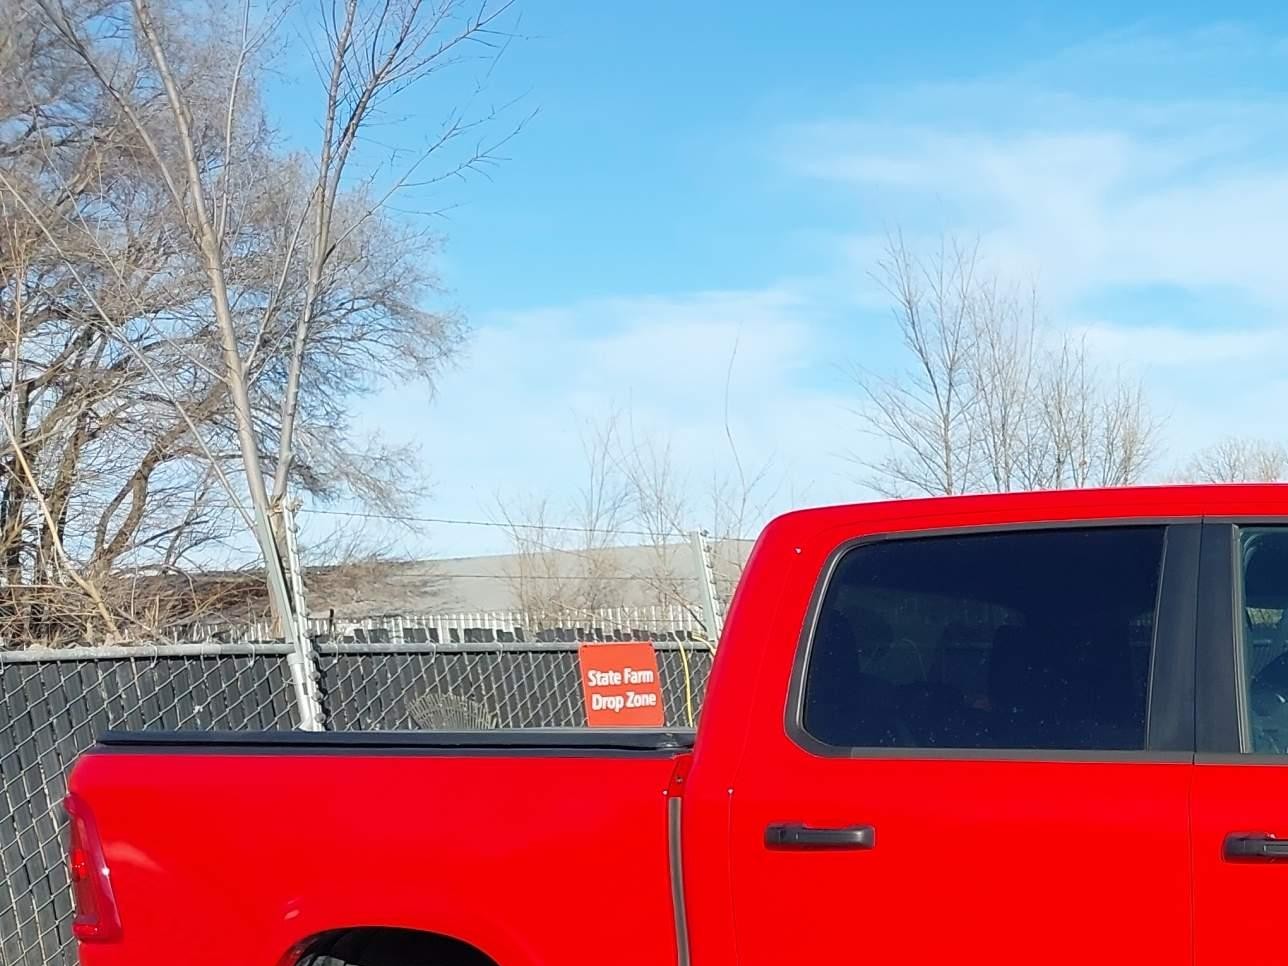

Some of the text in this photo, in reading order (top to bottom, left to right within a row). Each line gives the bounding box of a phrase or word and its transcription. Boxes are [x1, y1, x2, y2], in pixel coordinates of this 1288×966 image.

[588, 668, 653, 686] State Farm
[592, 691, 656, 712] Drop Zone
